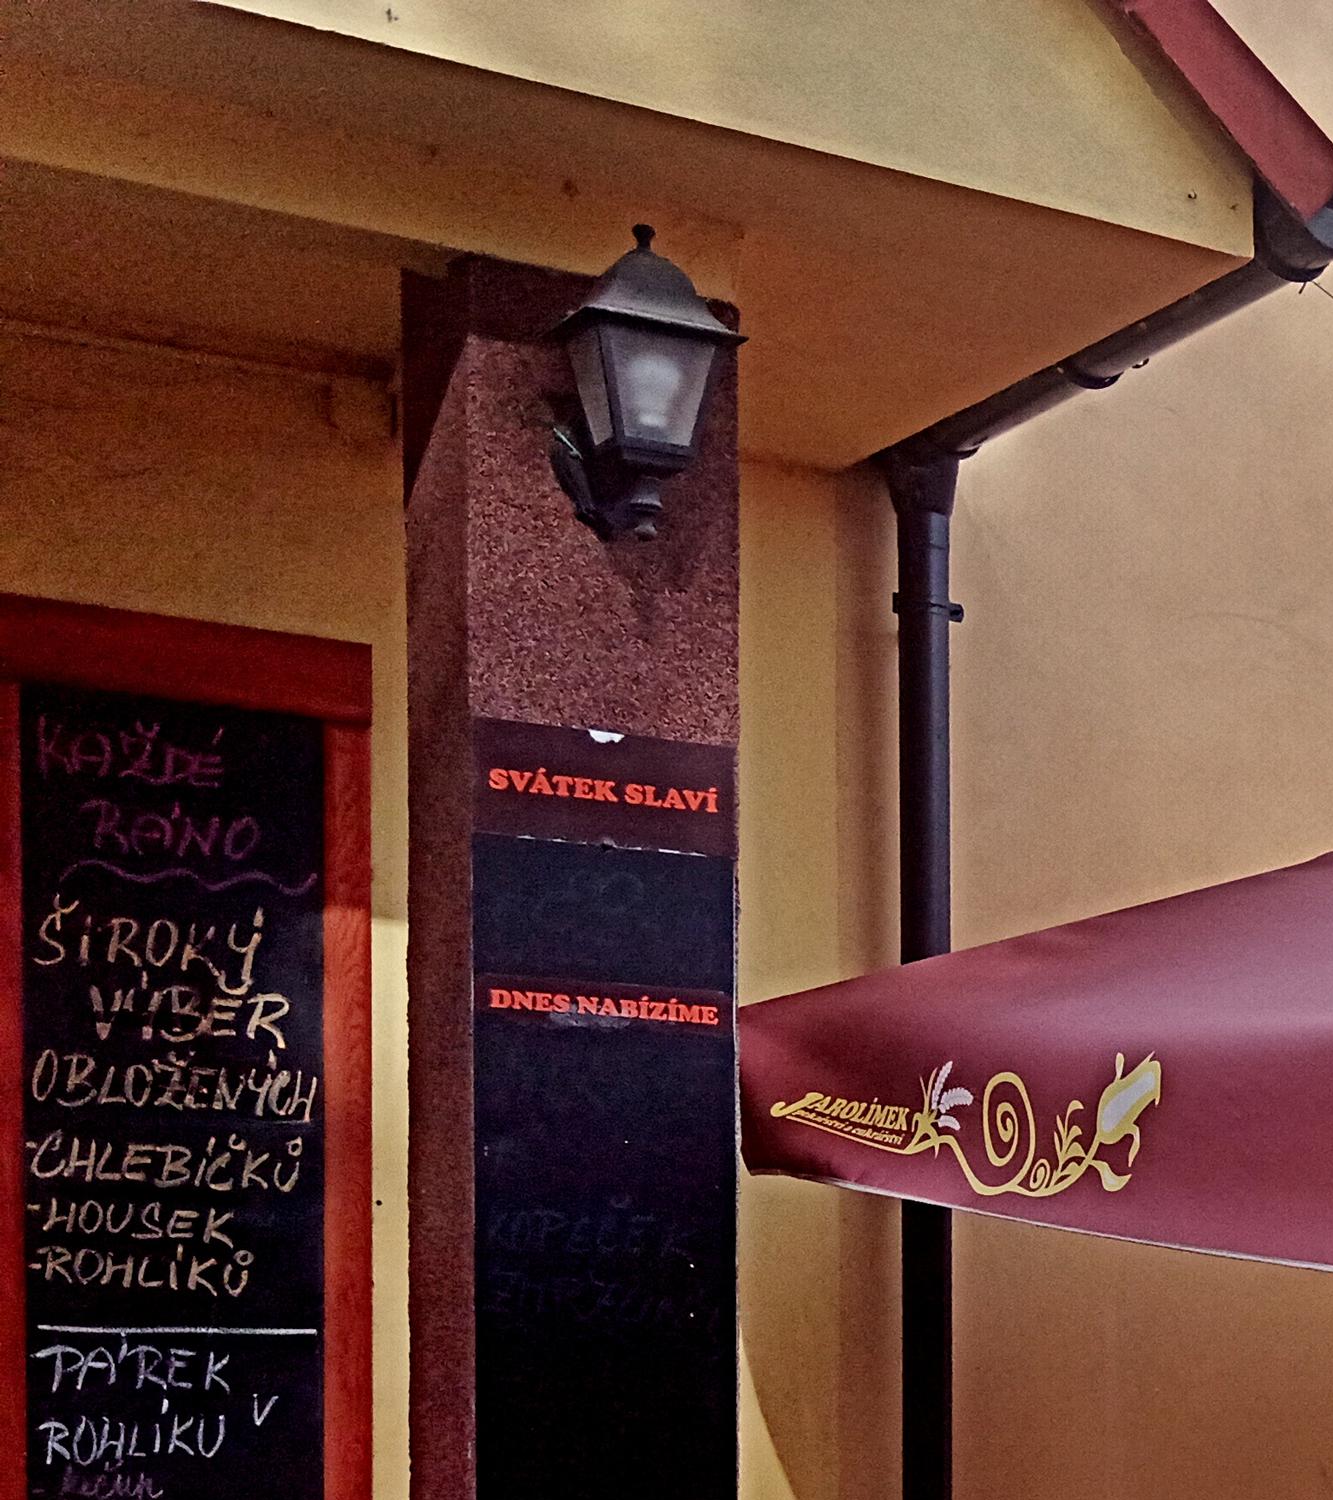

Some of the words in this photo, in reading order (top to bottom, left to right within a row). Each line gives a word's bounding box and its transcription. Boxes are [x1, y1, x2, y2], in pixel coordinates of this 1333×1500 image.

[488, 767, 618, 803] SVÁTEK
[624, 783, 719, 813] SLAVÍ
[489, 988, 574, 1014] DNES
[576, 995, 719, 1026] NABÍZÍME
[32, 1048, 317, 1123] OBLOŽENÝCH
[770, 1091, 910, 1131] JAROLÍMEK
[30, 1333, 231, 1393] PÁREK
[38, 1398, 225, 1465] ROHLÍKU
